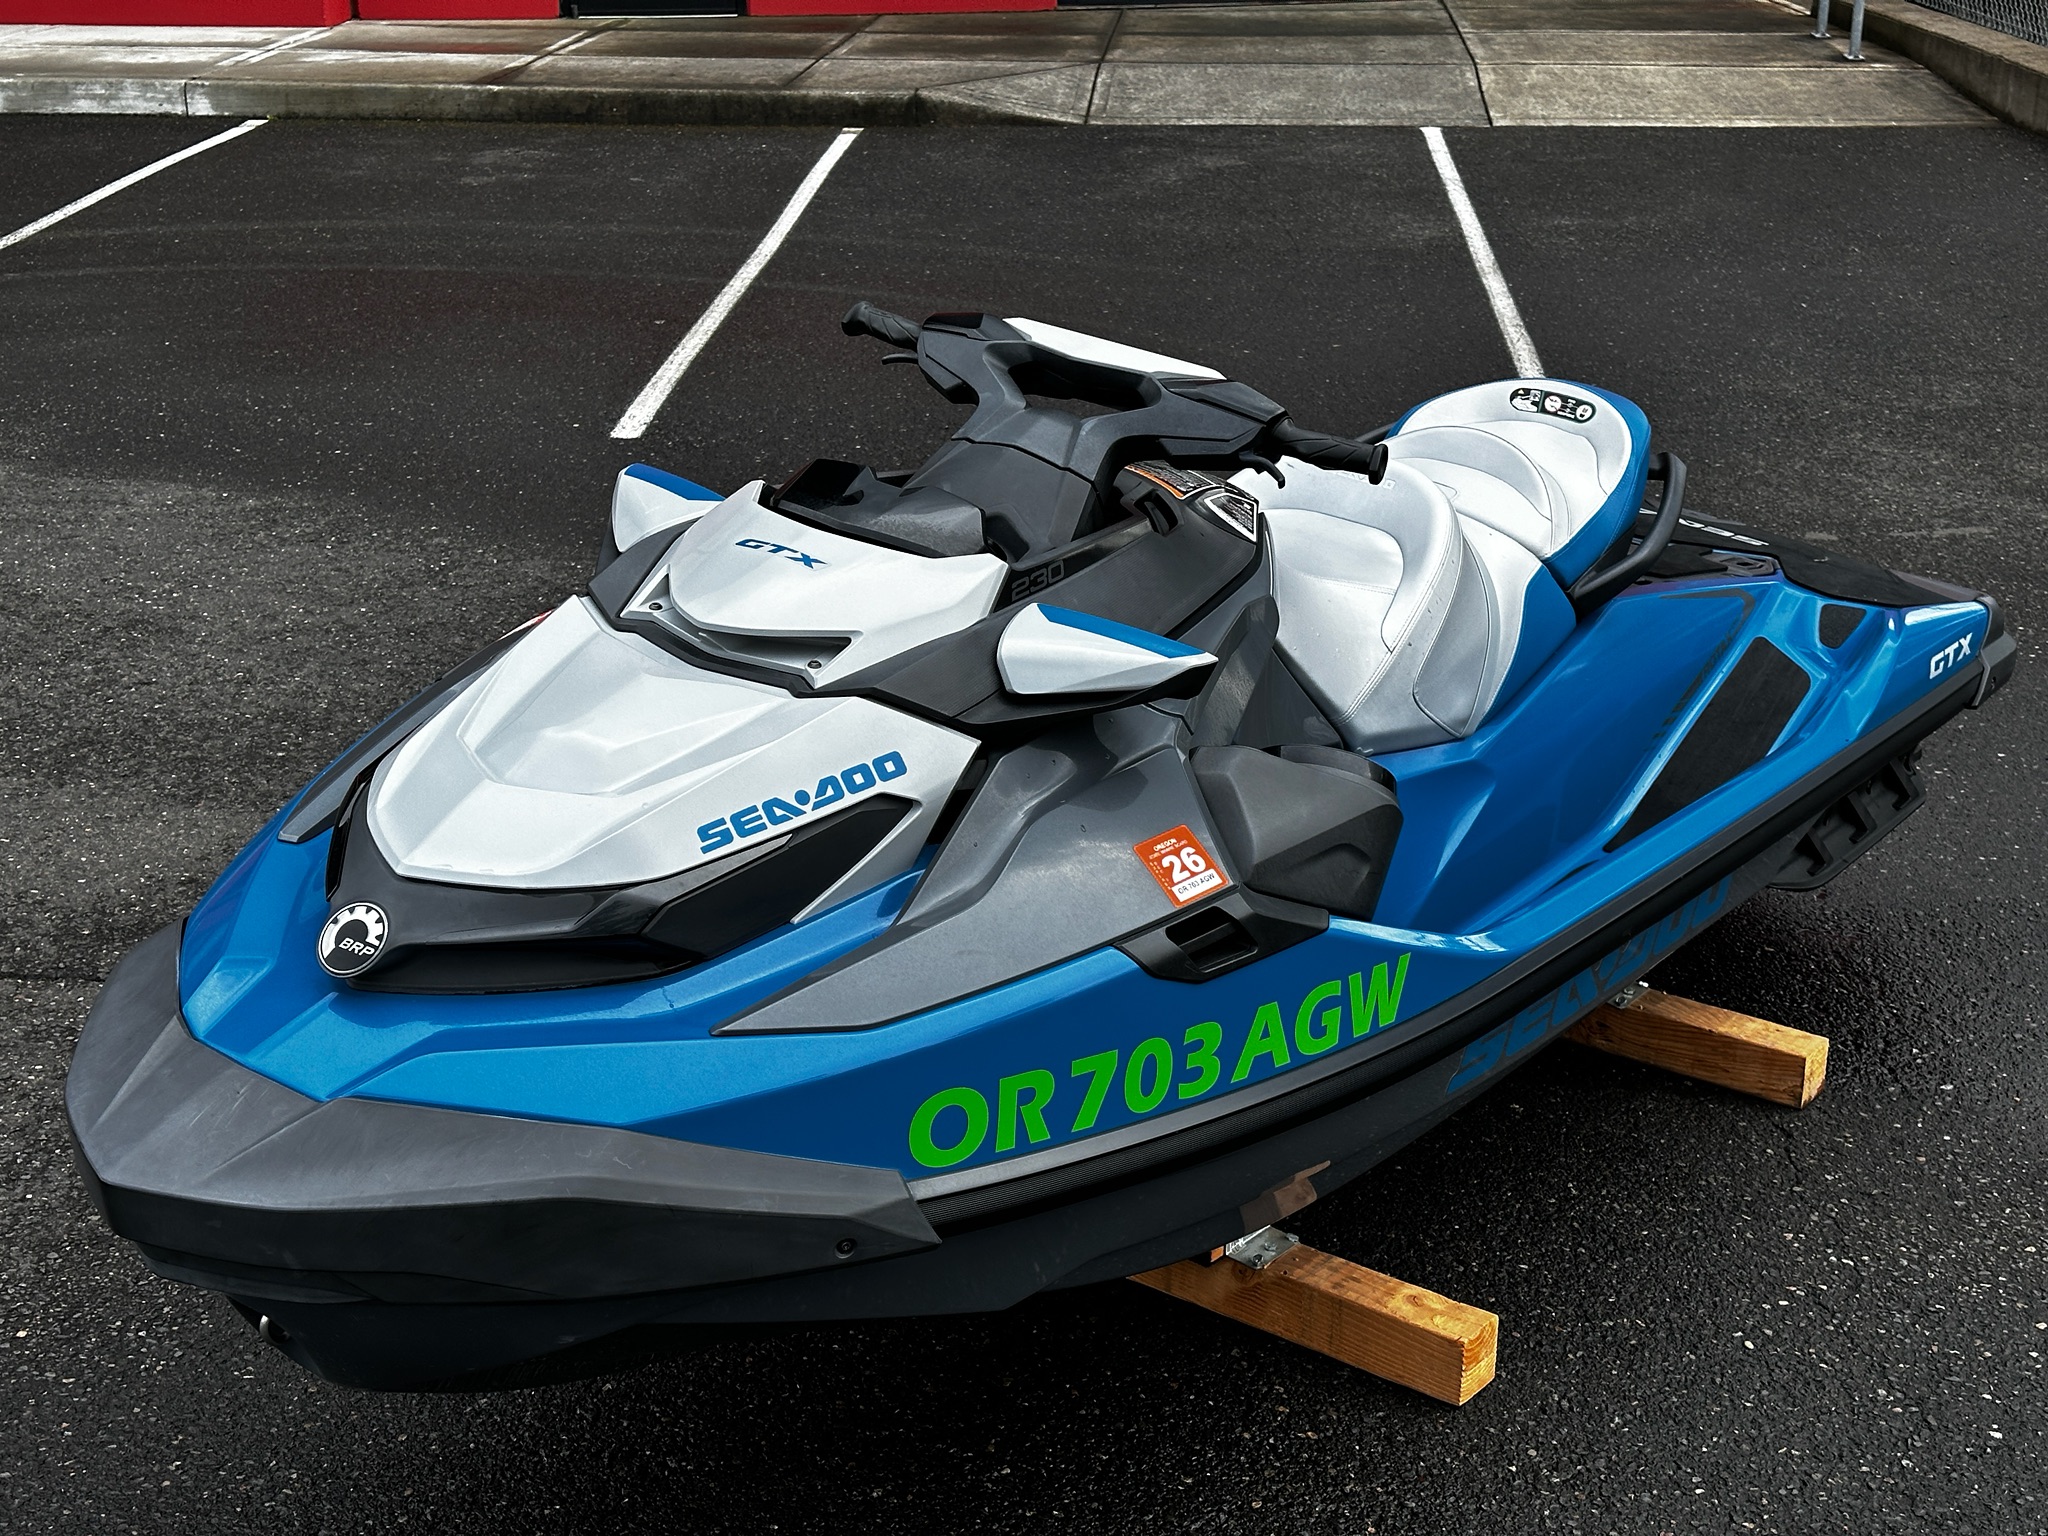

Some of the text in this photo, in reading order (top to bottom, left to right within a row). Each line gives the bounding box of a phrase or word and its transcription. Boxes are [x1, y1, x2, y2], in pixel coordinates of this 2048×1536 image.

[735, 538, 828, 569] GTX
[1011, 560, 1065, 602] 230
[1929, 632, 1973, 680] GTX
[1153, 838, 1177, 851] OREGON
[1161, 846, 1207, 884] 26
[339, 938, 375, 955] BRP
[908, 952, 1412, 1169] OR 703 AGW
